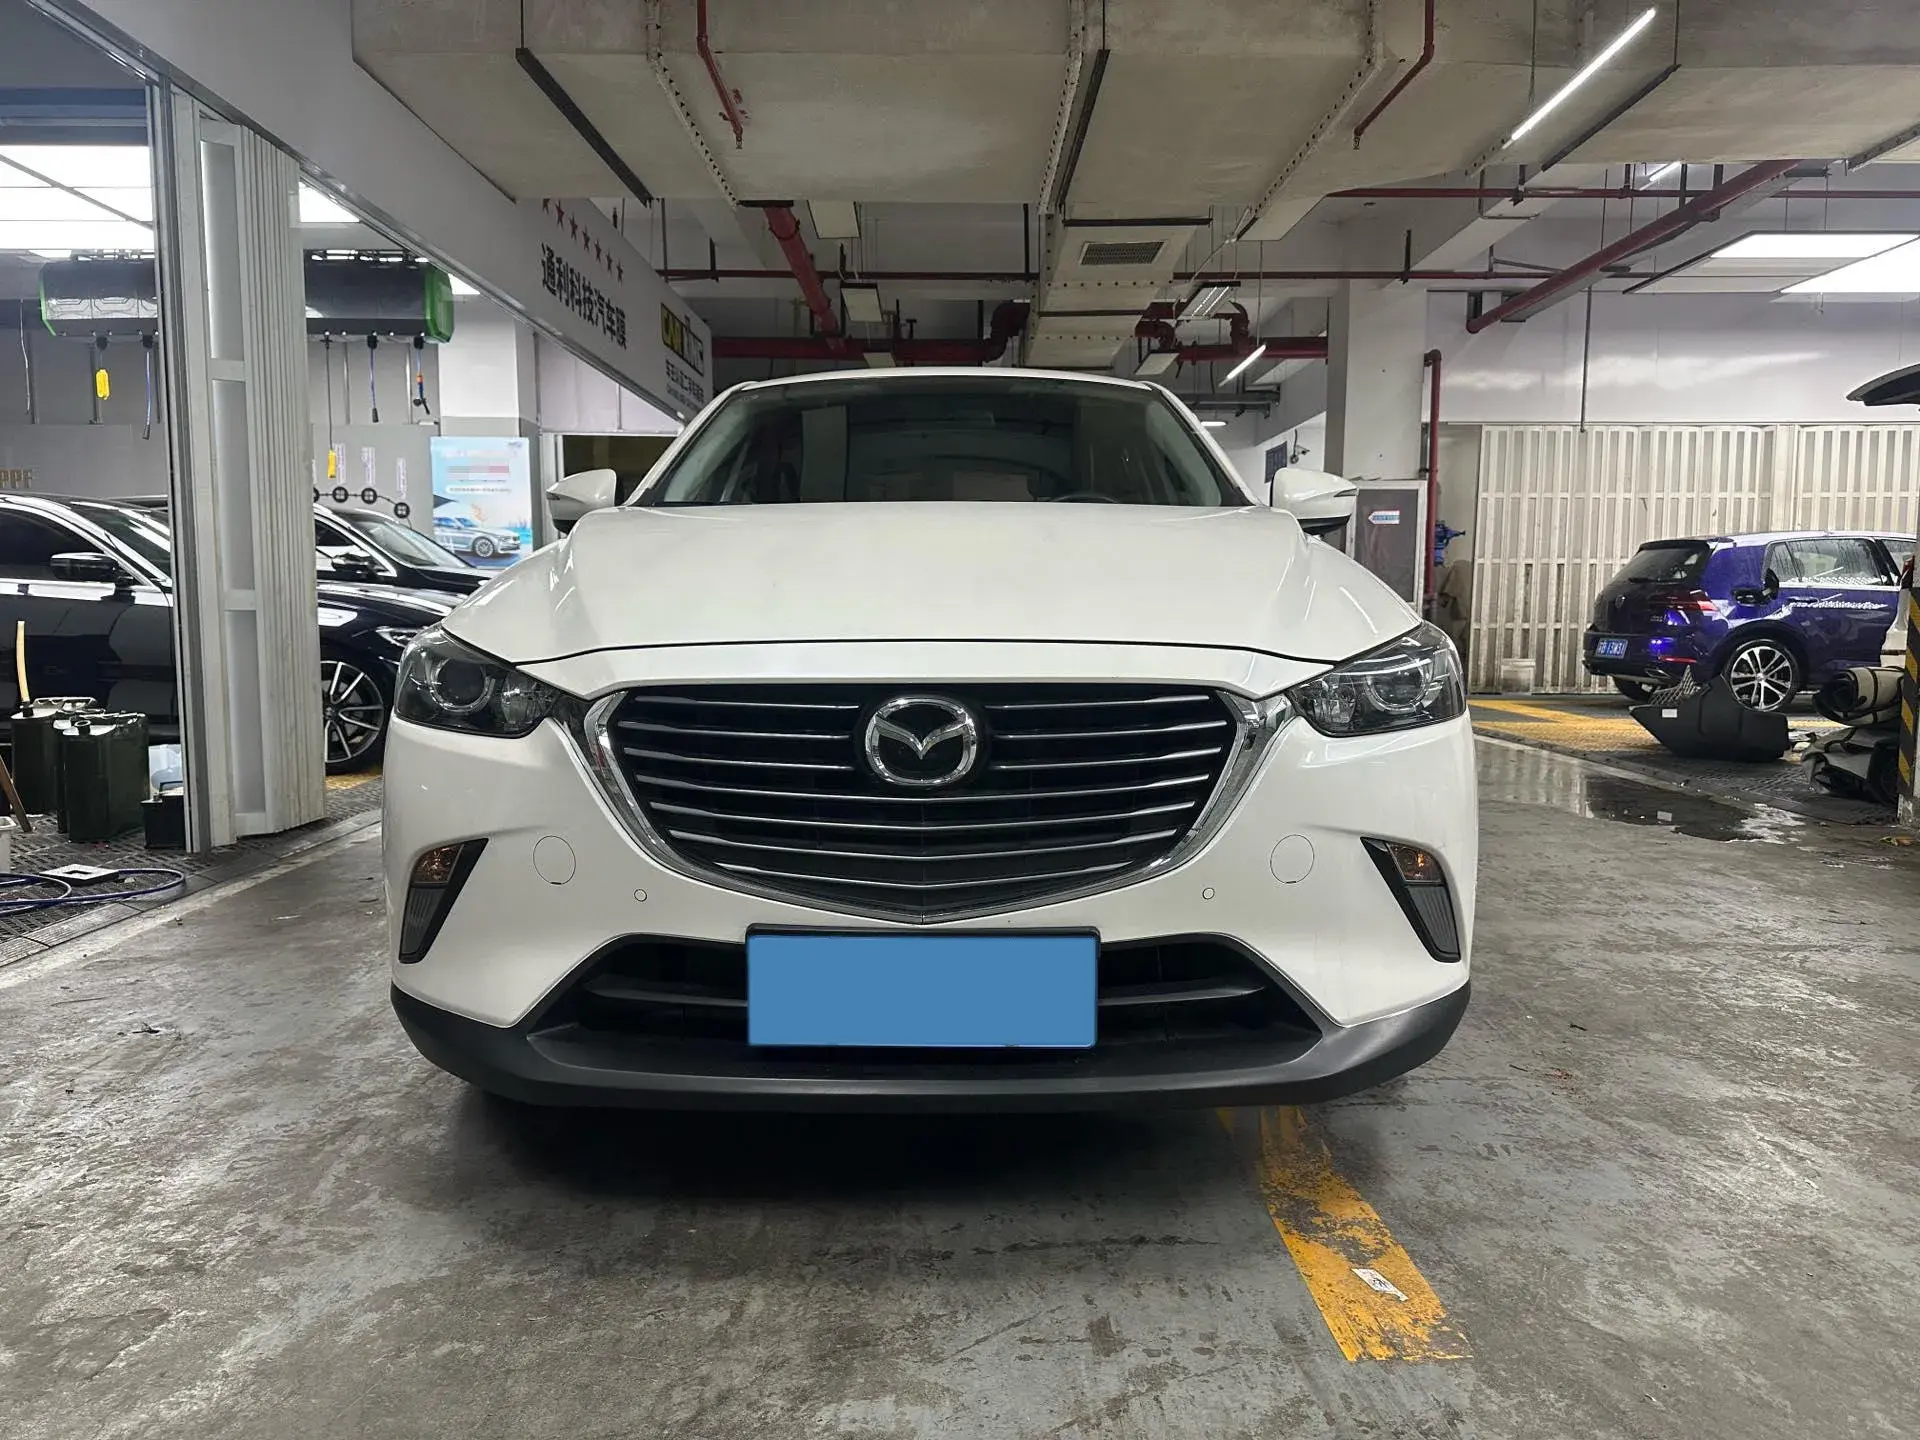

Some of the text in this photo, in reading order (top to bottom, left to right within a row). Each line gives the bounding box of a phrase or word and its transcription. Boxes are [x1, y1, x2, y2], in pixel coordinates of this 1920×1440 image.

[541, 242, 627, 349] 通利科技汽车膜
